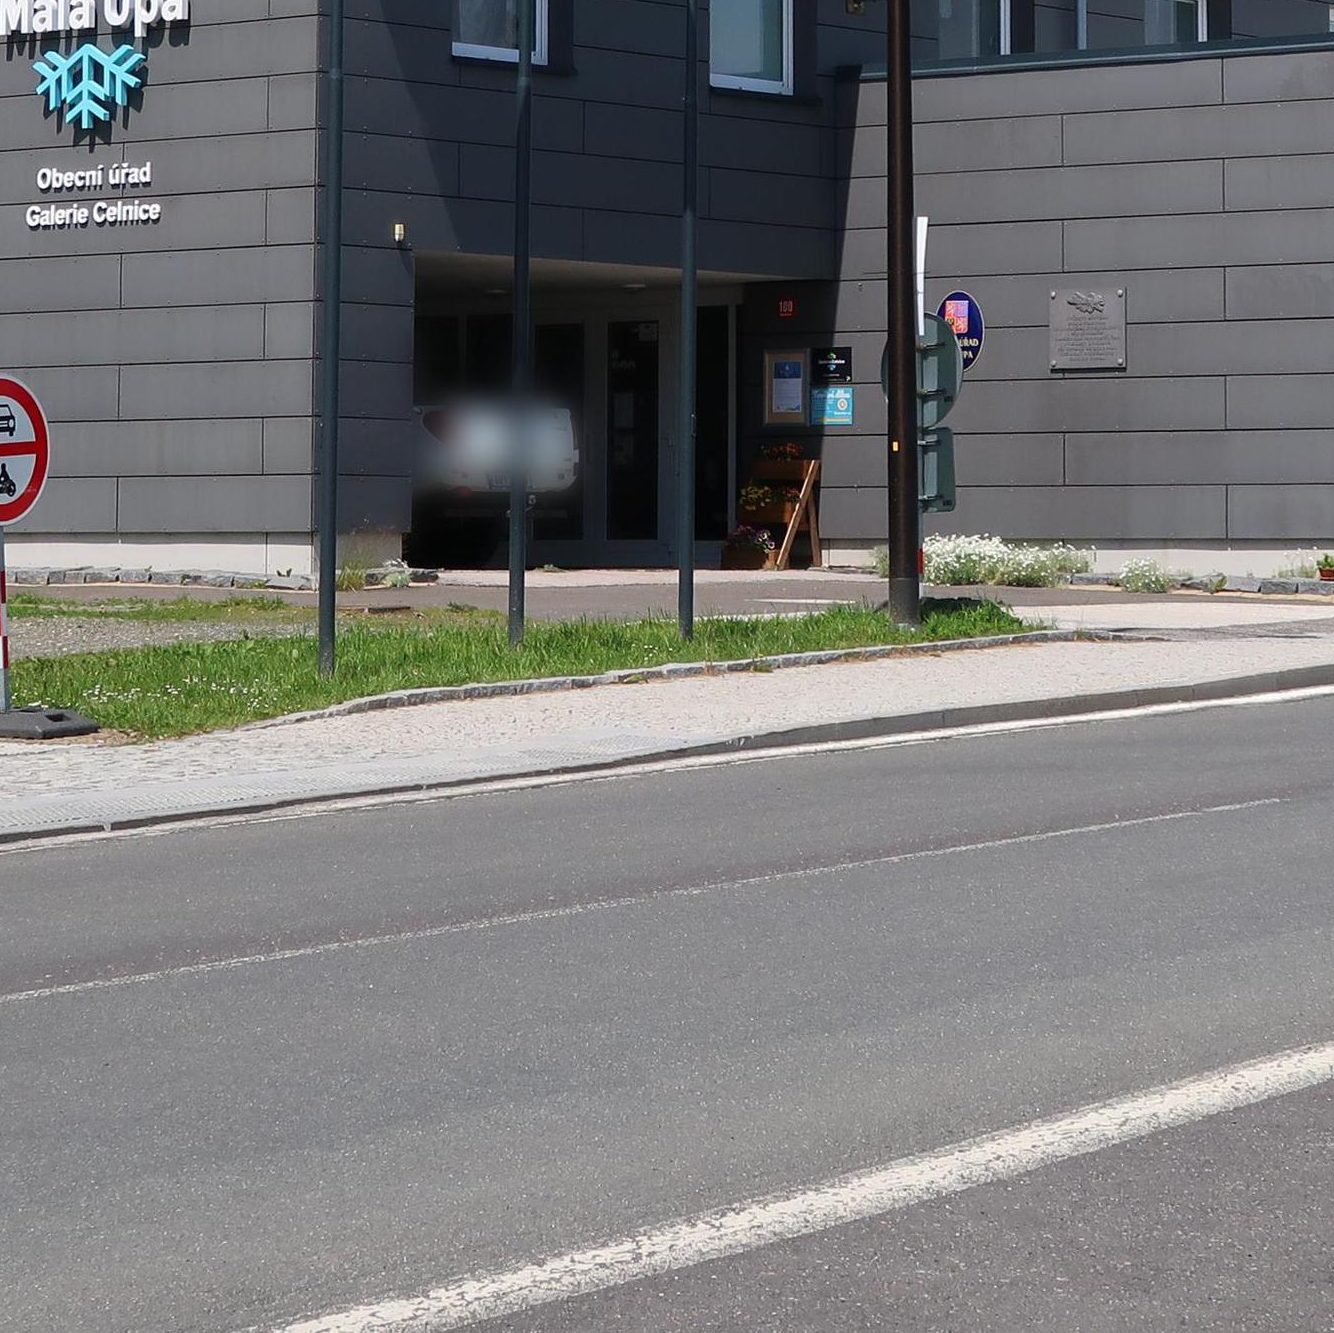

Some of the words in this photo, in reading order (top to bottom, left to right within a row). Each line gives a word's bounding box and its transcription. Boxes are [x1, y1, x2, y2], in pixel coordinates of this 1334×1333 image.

[36, 164, 104, 189] Obecní
[108, 161, 152, 185] úřad
[25, 203, 89, 227] Galerie
[92, 200, 161, 223] Celnice
